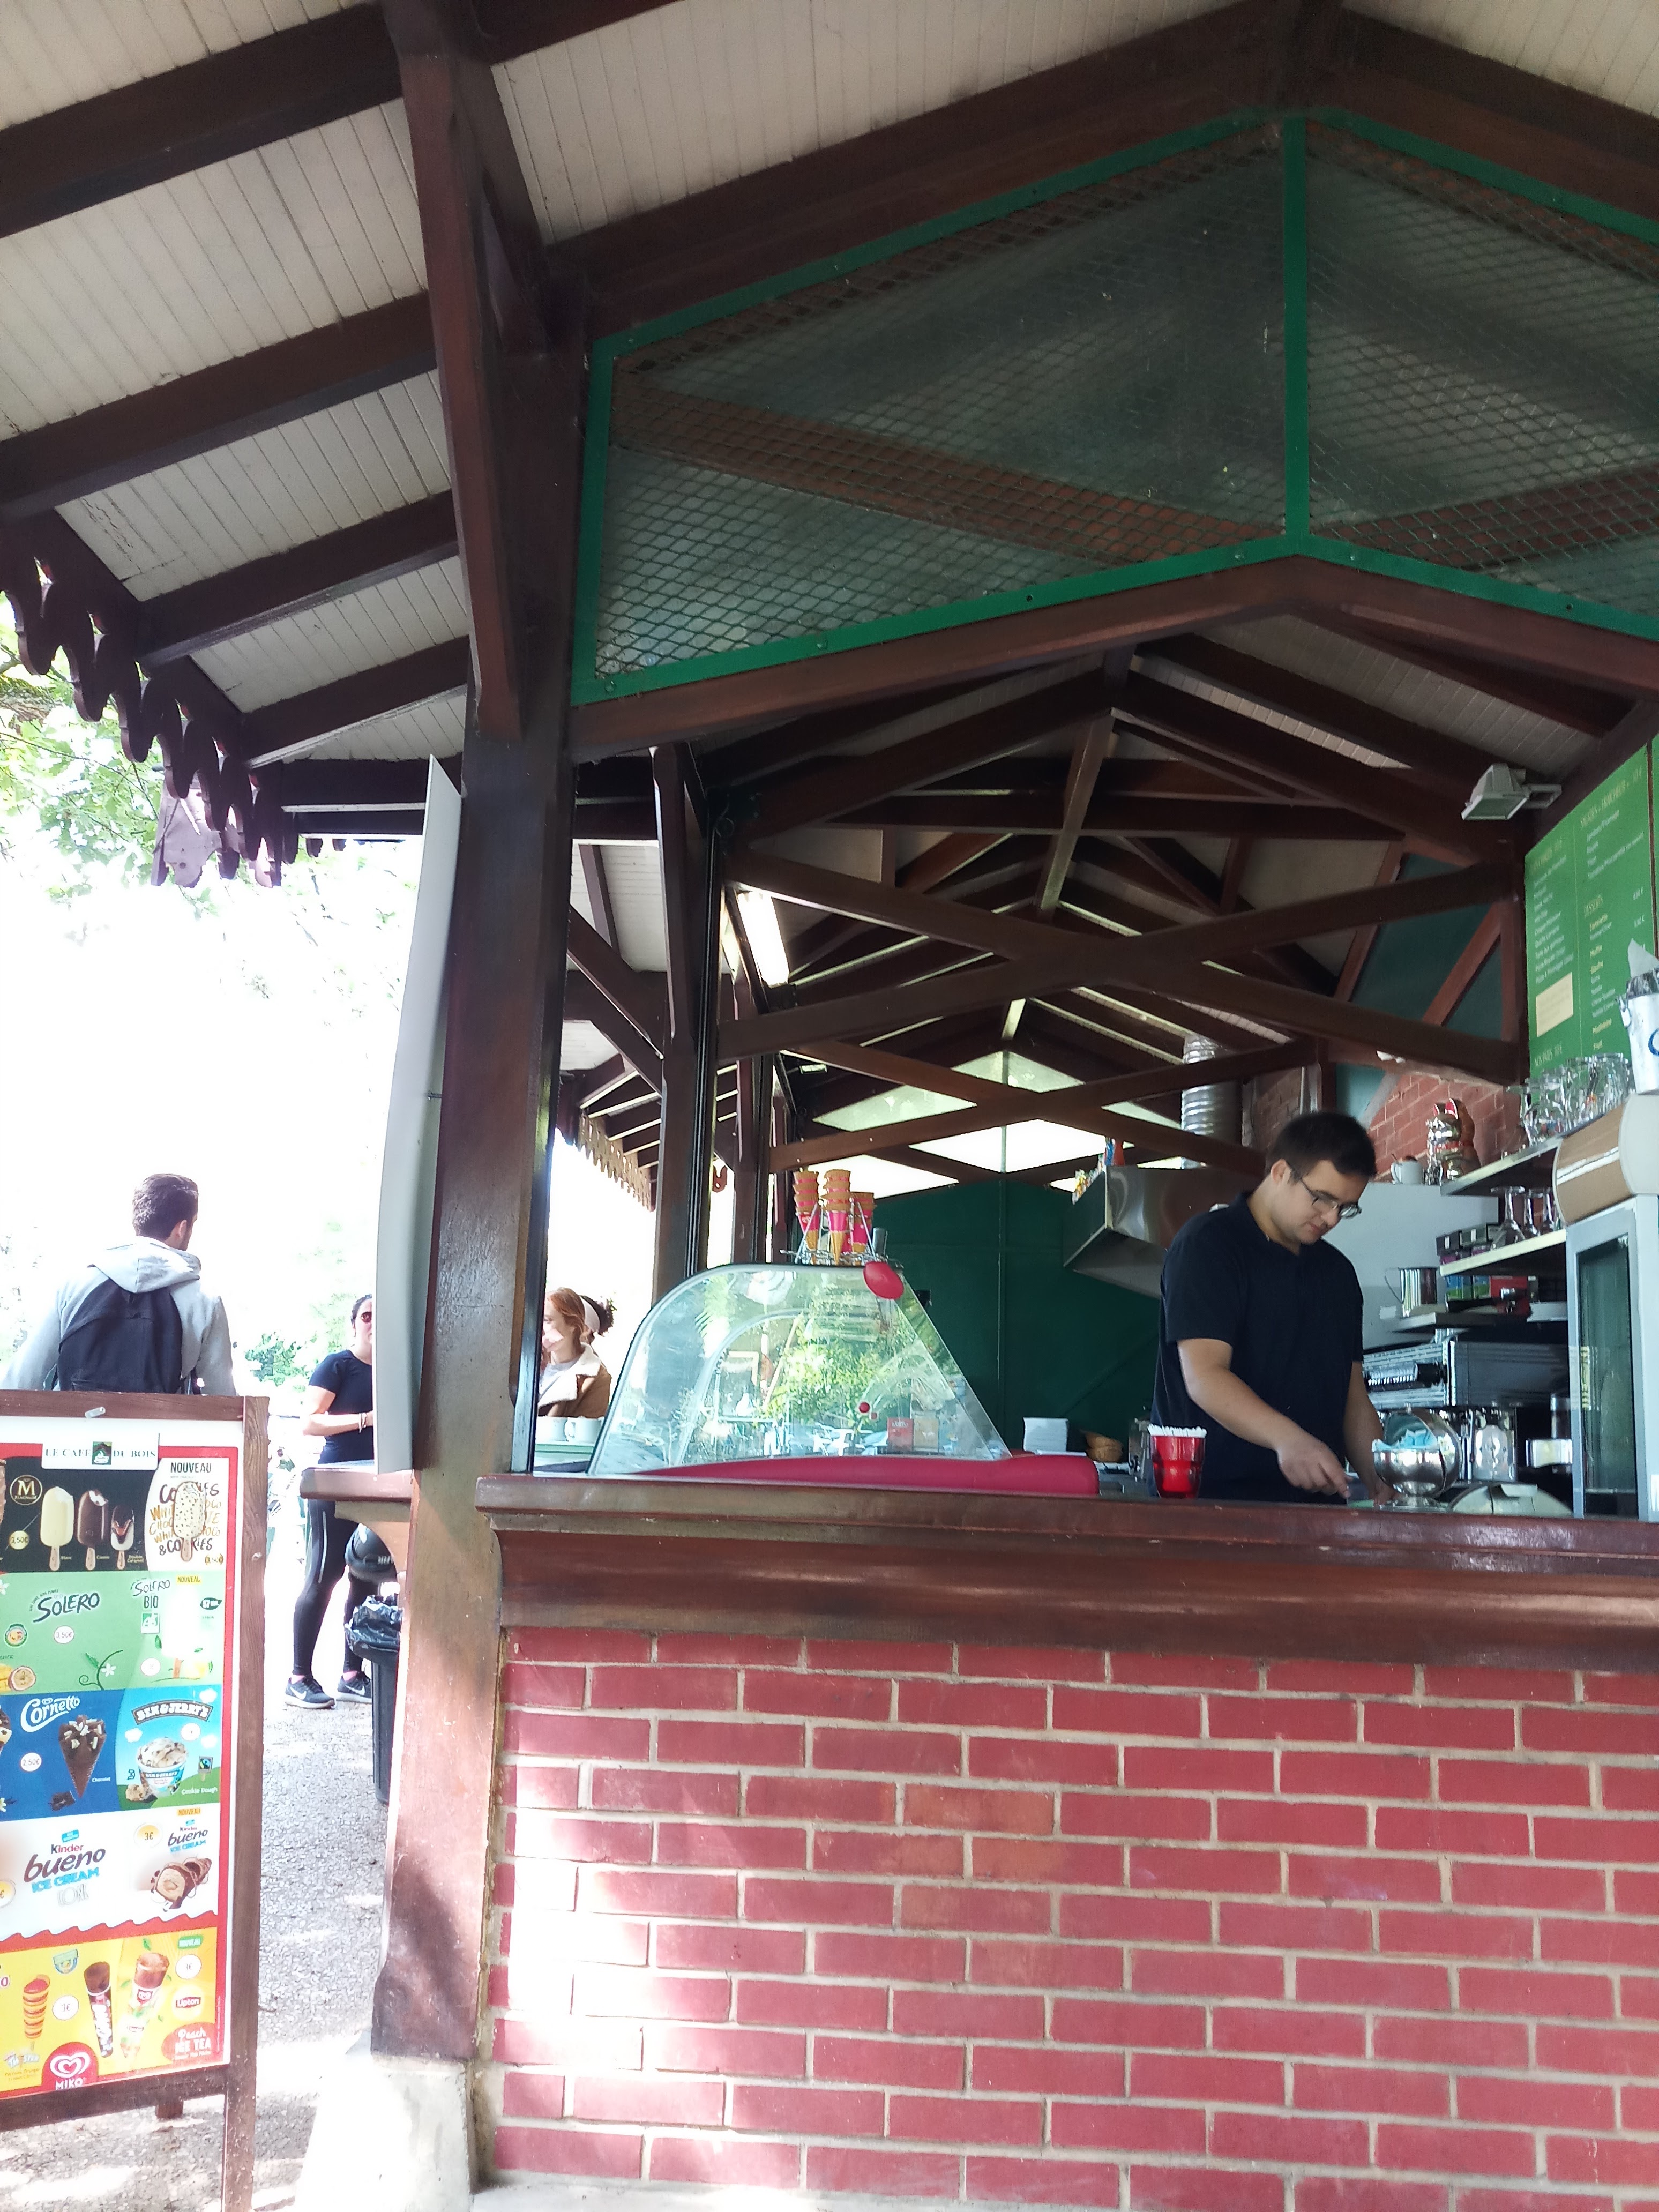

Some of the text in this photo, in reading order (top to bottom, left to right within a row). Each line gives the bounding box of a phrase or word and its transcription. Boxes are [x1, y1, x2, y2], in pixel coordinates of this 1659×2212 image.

[131, 1449, 155, 1458] BOIS
[170, 1462, 212, 1473] NOUVEAU
[132, 1580, 170, 1596] SOLERO
[33, 1592, 100, 1623] SOLERO
[144, 1595, 159, 1609] BIO
[20, 1695, 80, 1732] Cornetto
[136, 1705, 160, 1721] BEN
[168, 1703, 209, 1718] JERRY'S
[178, 1807, 201, 1816] NOUVEAU
[145, 1832, 154, 1841] 3€
[168, 1829, 208, 1847] bueno
[24, 1848, 106, 1883] bueno
[31, 1867, 100, 1893] ICE CREAM
[62, 2003, 71, 2012] 3€
[177, 1998, 199, 2007] Lipton
[177, 2026, 207, 2041] Peach
[175, 2037, 211, 2054] ICE TEA
[55, 2077, 83, 2090] MIKO
